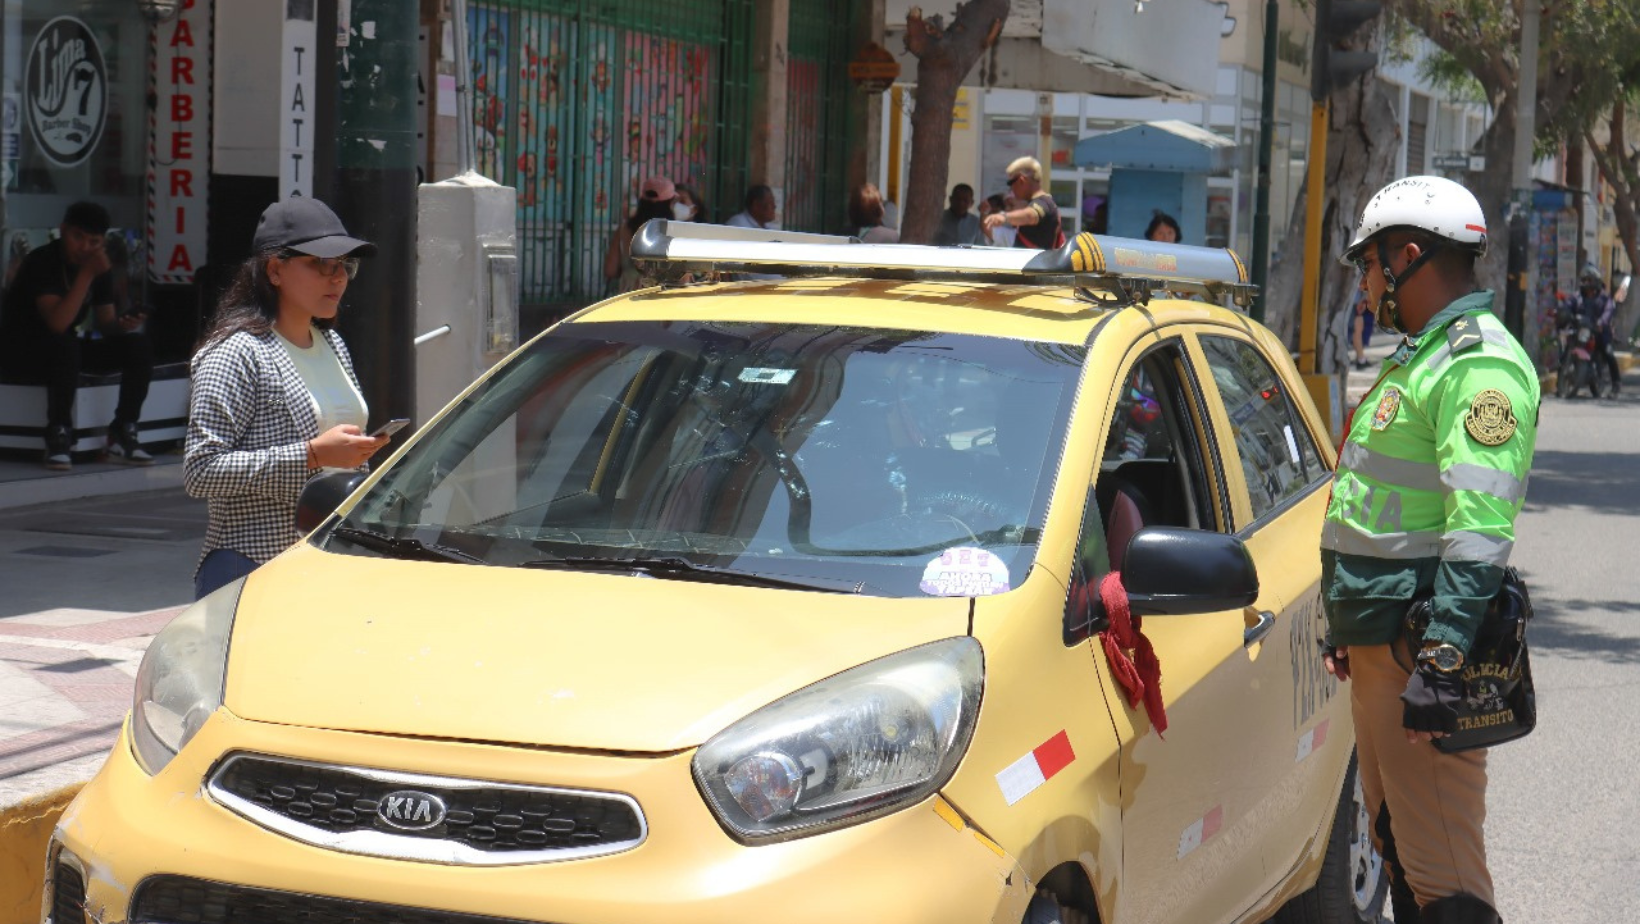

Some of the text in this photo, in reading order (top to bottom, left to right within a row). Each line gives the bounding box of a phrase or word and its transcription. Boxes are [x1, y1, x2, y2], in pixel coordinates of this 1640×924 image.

[74, 68, 96, 116] 7
[1462, 662, 1509, 680] OLICIA
[1457, 708, 1514, 730] TRANSITO
[386, 796, 431, 822] KIA
